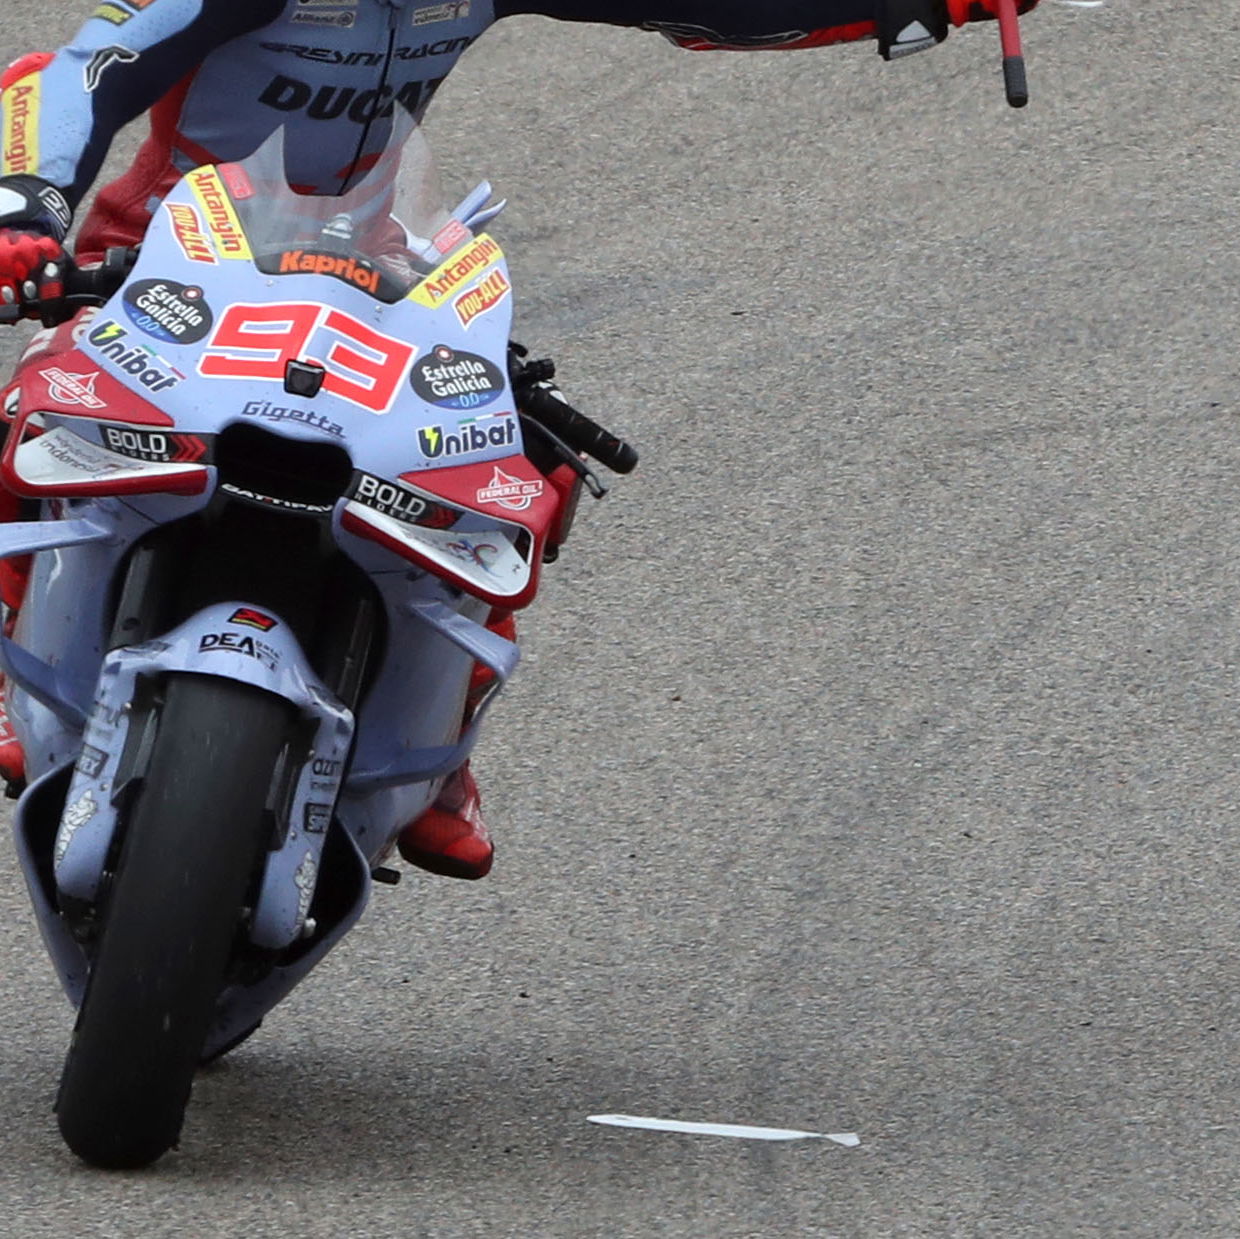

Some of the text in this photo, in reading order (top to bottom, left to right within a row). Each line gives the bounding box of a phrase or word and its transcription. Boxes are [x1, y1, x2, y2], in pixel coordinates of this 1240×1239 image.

[257, 74, 449, 125] DUCAT
[191, 172, 243, 252] Antangin
[280, 250, 381, 295] Kapriol
[424, 239, 499, 303] Antangin
[135, 293, 187, 336] Galicia
[147, 283, 204, 327] Estrella
[456, 269, 508, 321] YOU-ALL
[88, 320, 179, 394] Unibat
[197, 300, 418, 415] 93
[421, 360, 487, 382] Estrella
[431, 373, 493, 398] Galicia
[106, 427, 167, 454] BOLD
[241, 400, 346, 440] Gigetta
[417, 417, 517, 459] Unibat
[357, 474, 427, 517] BOLD
[479, 485, 521, 499] FEDERAL
[199, 632, 256, 658] DEA
